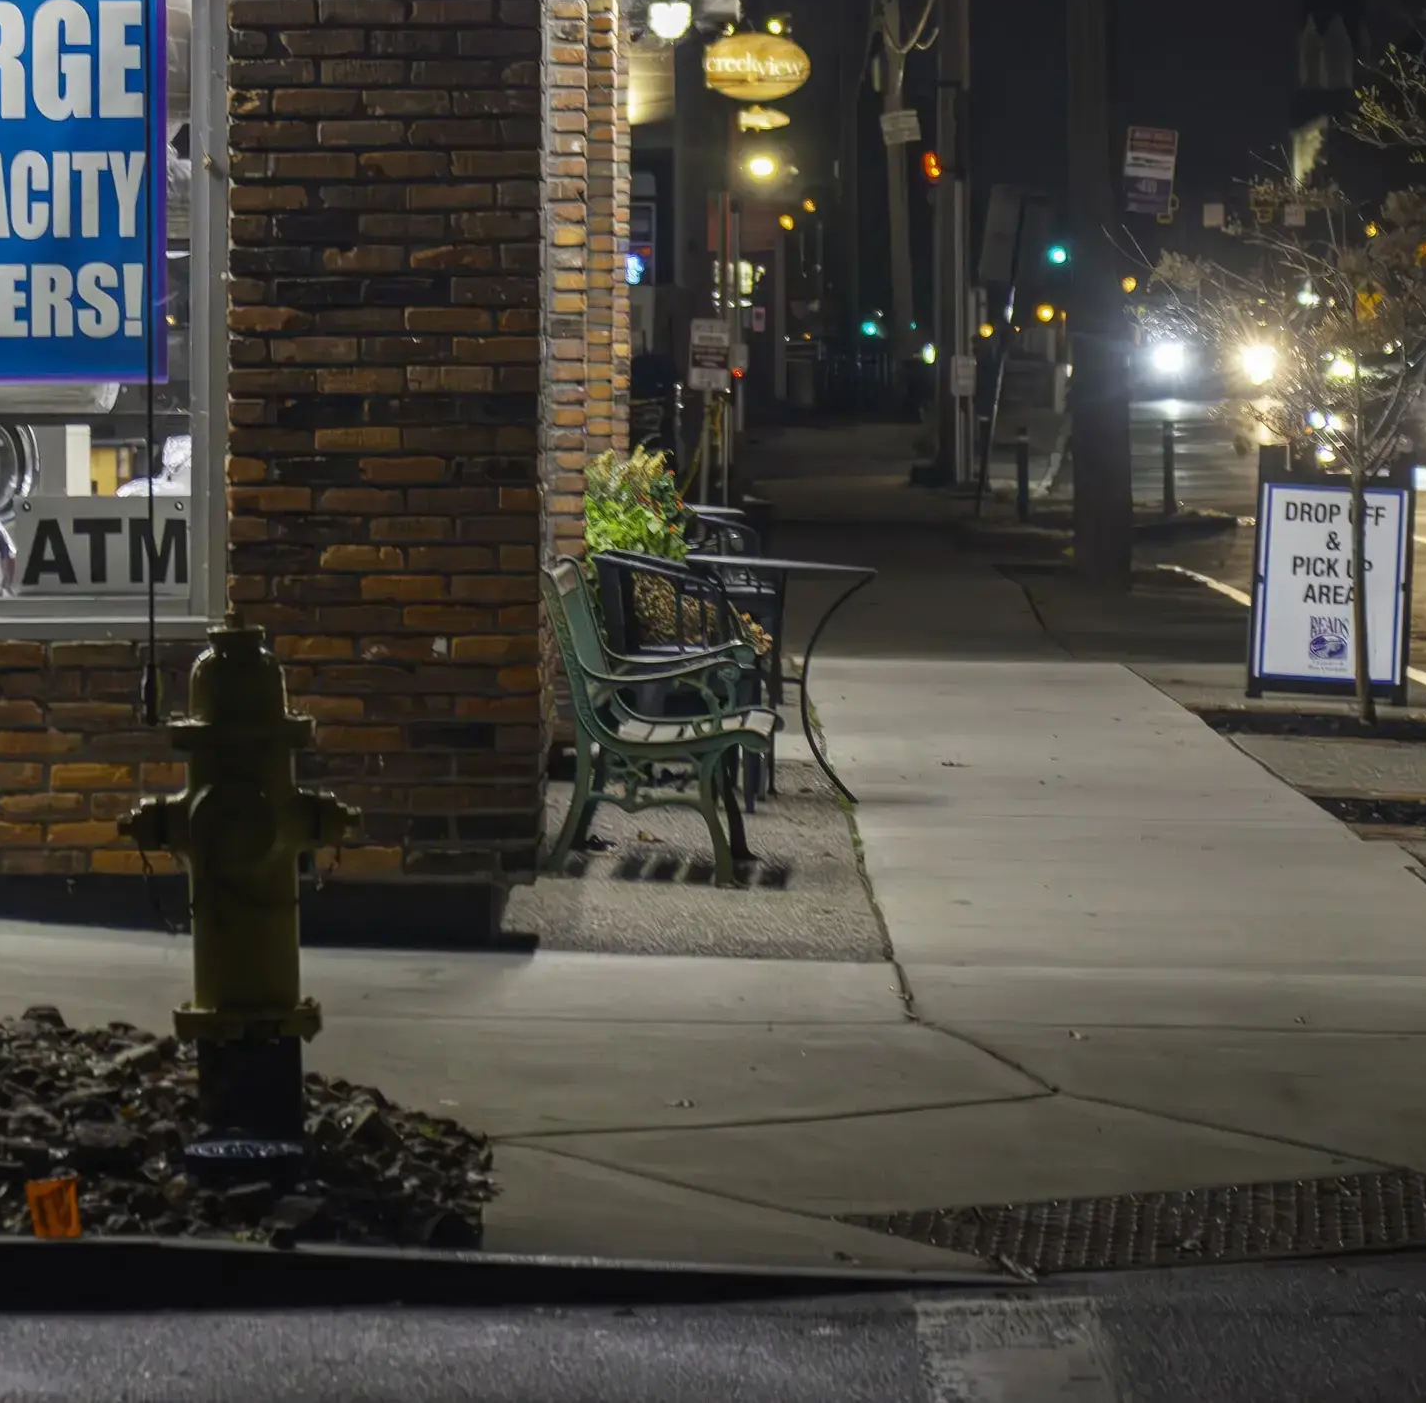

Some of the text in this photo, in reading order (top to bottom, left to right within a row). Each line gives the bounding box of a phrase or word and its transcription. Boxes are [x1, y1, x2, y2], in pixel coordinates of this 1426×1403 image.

[1285, 502, 1341, 523] DROP
[1326, 531, 1341, 550] &
[21, 518, 189, 586] ATM
[1292, 556, 1339, 578] PICK
[1303, 583, 1354, 605] AREA
